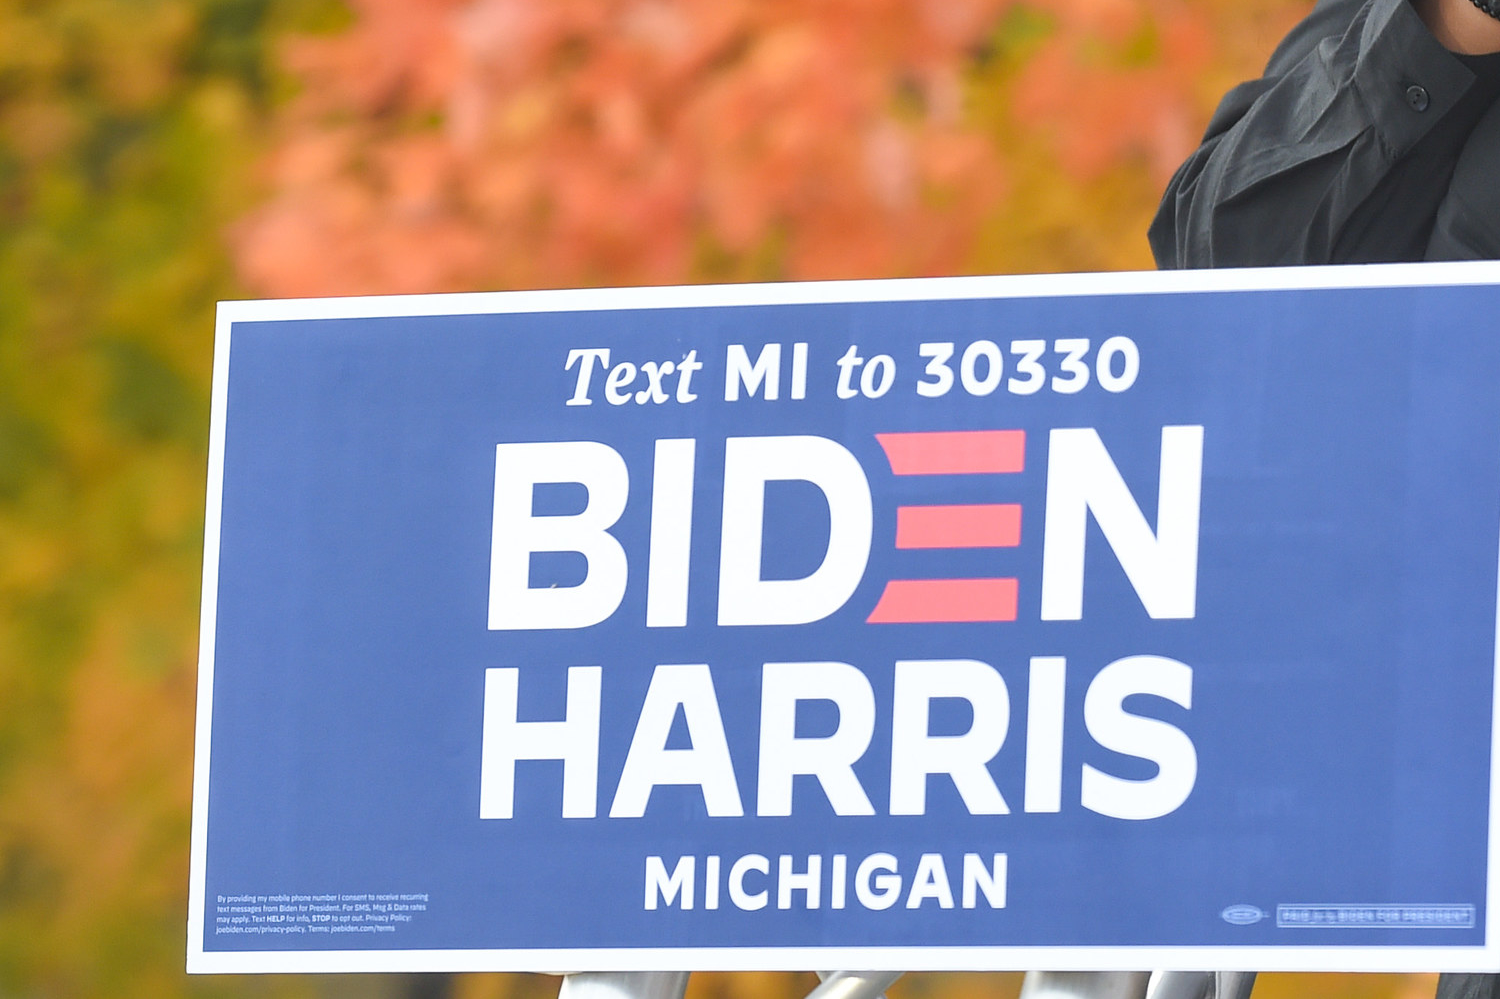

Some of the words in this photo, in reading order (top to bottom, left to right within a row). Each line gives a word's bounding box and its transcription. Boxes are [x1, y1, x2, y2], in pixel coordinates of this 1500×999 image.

[565, 349, 702, 405] Text
[725, 343, 808, 401] MI
[837, 345, 895, 399] to
[917, 336, 1139, 397] 30330
[488, 425, 1204, 630] BIDEN
[480, 655, 1197, 820] HARRIS
[227, 895, 256, 903] providing
[291, 895, 311, 903] phone
[400, 894, 428, 902] recurring
[645, 853, 1007, 910] MICHIGAN
[297, 915, 310, 923] info,
[340, 915, 350, 923] opt
[366, 915, 388, 923] Privacy
